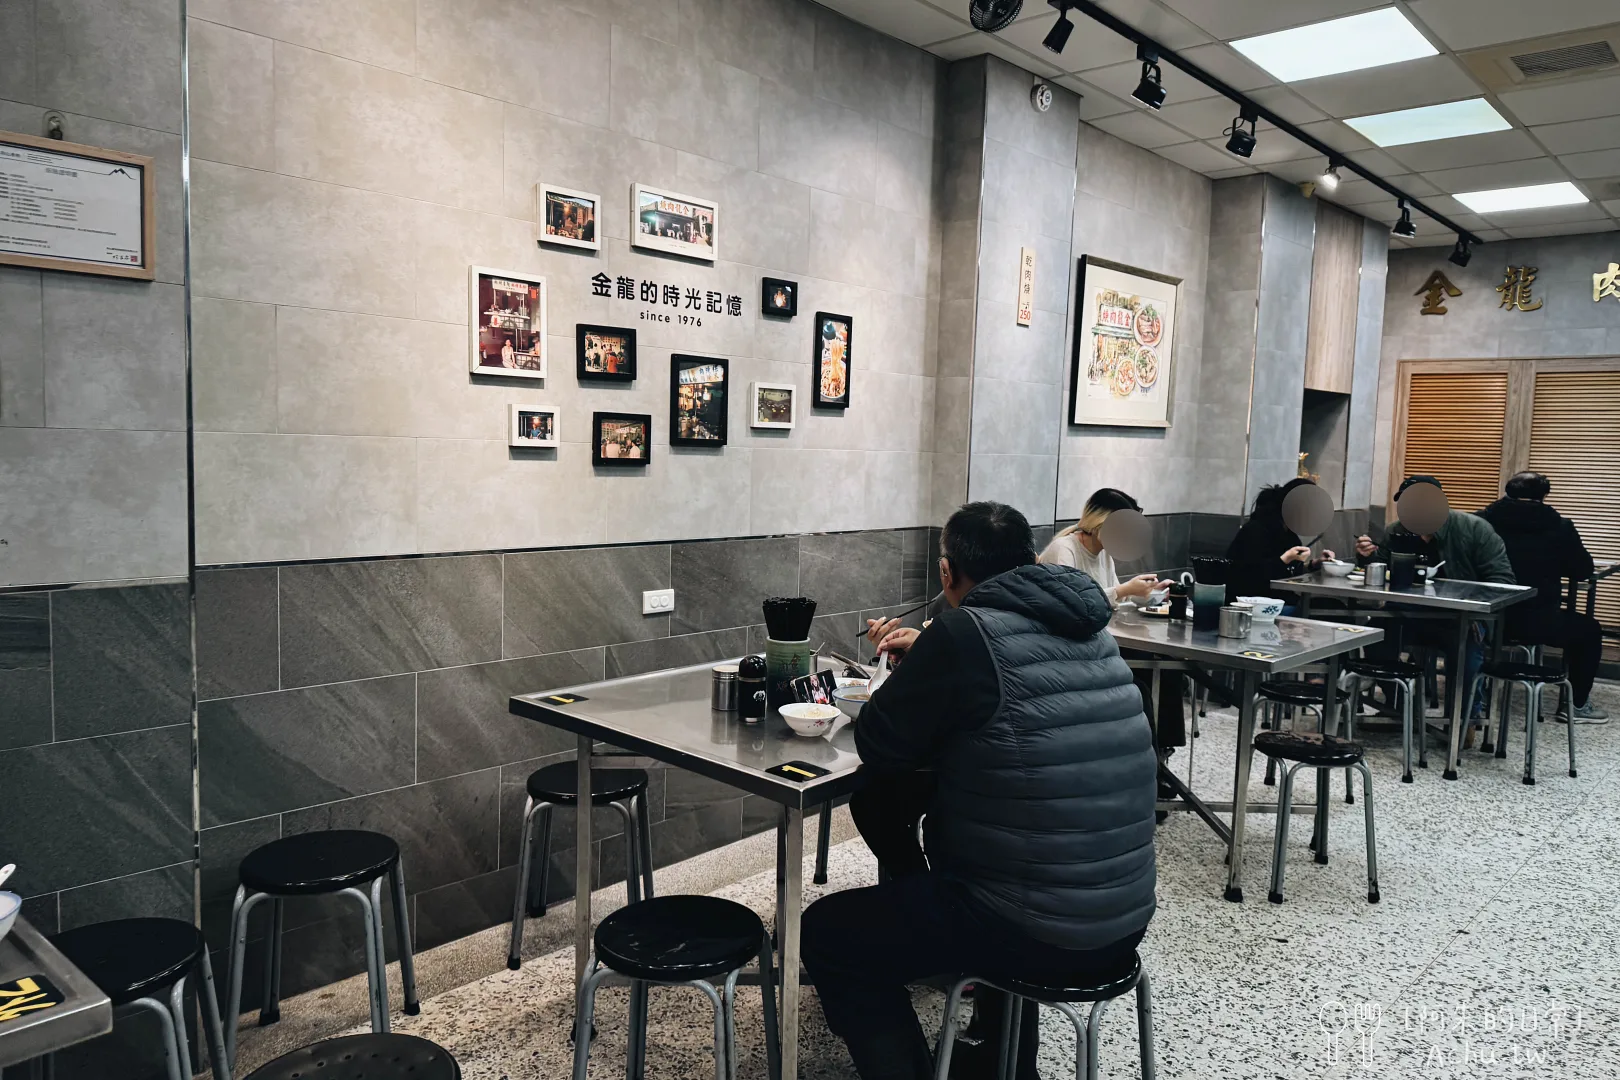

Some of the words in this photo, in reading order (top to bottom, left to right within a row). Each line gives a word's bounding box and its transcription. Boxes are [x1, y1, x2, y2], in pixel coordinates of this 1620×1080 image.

[591, 272, 742, 317] 金龍的時光記憶
[639, 310, 671, 323] since
[677, 314, 702, 327] 1976
[1019, 309, 1031, 321] 250
[781, 765, 817, 778] 1
